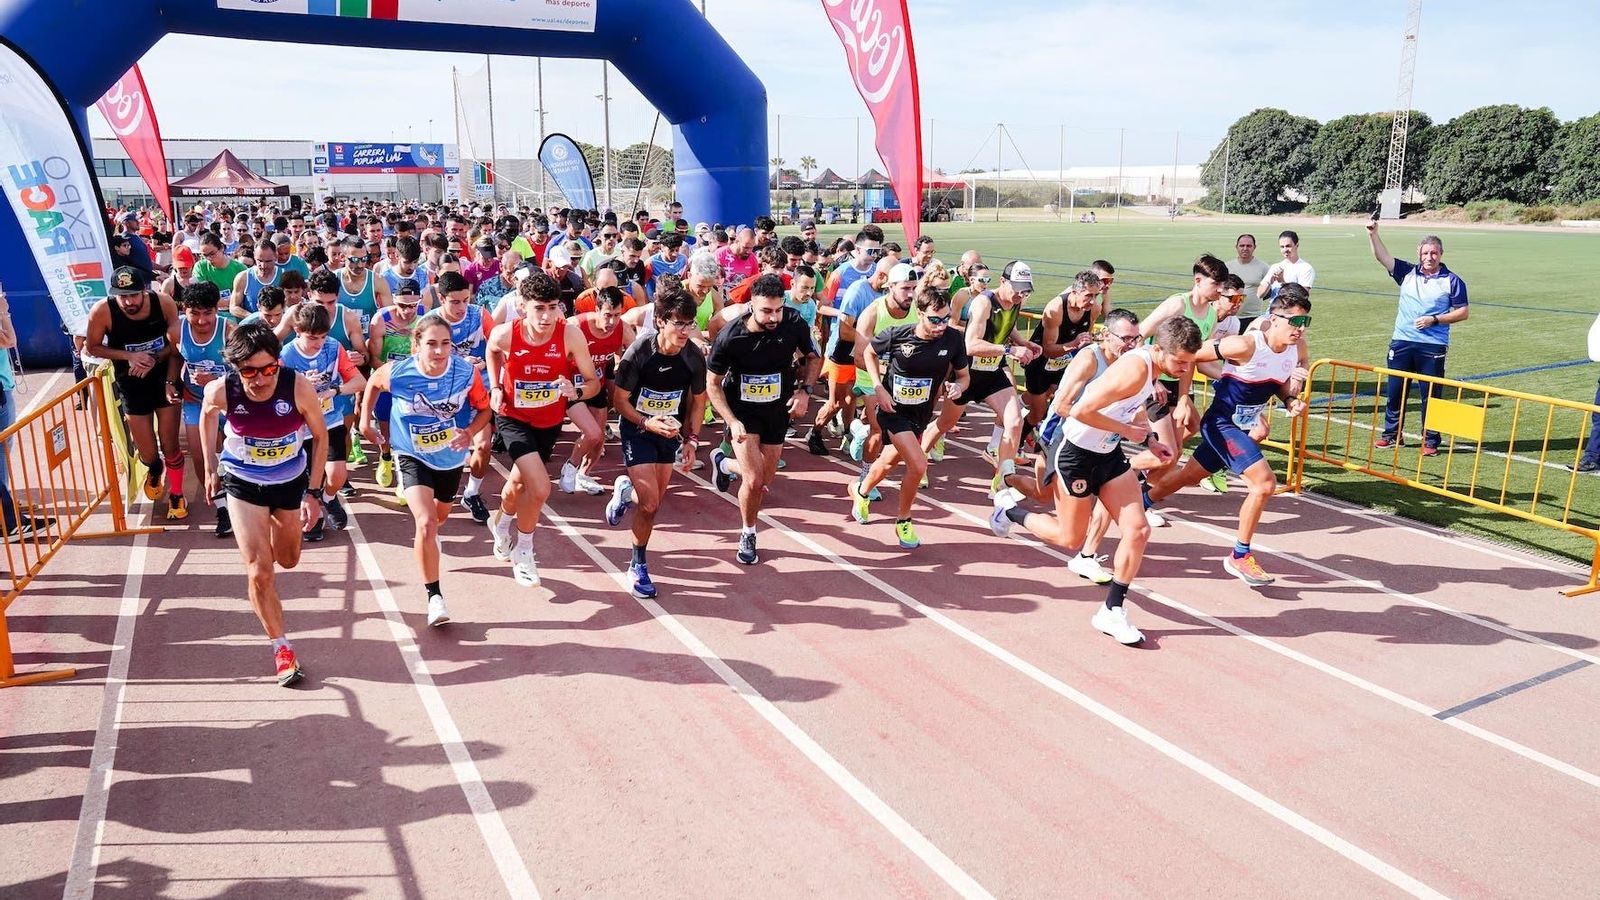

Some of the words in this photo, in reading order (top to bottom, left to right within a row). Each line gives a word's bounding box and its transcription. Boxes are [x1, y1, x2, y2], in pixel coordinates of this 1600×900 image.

[562, 0, 591, 8] deporte
[353, 149, 385, 157] CARRERA
[353, 156, 384, 165] POPULAR
[385, 152, 403, 162] UAL
[750, 385, 771, 394] 571
[901, 387, 922, 396] 590
[525, 390, 550, 399] 570
[648, 400, 672, 409] 695
[421, 431, 448, 444] 508
[256, 446, 286, 456] 567
